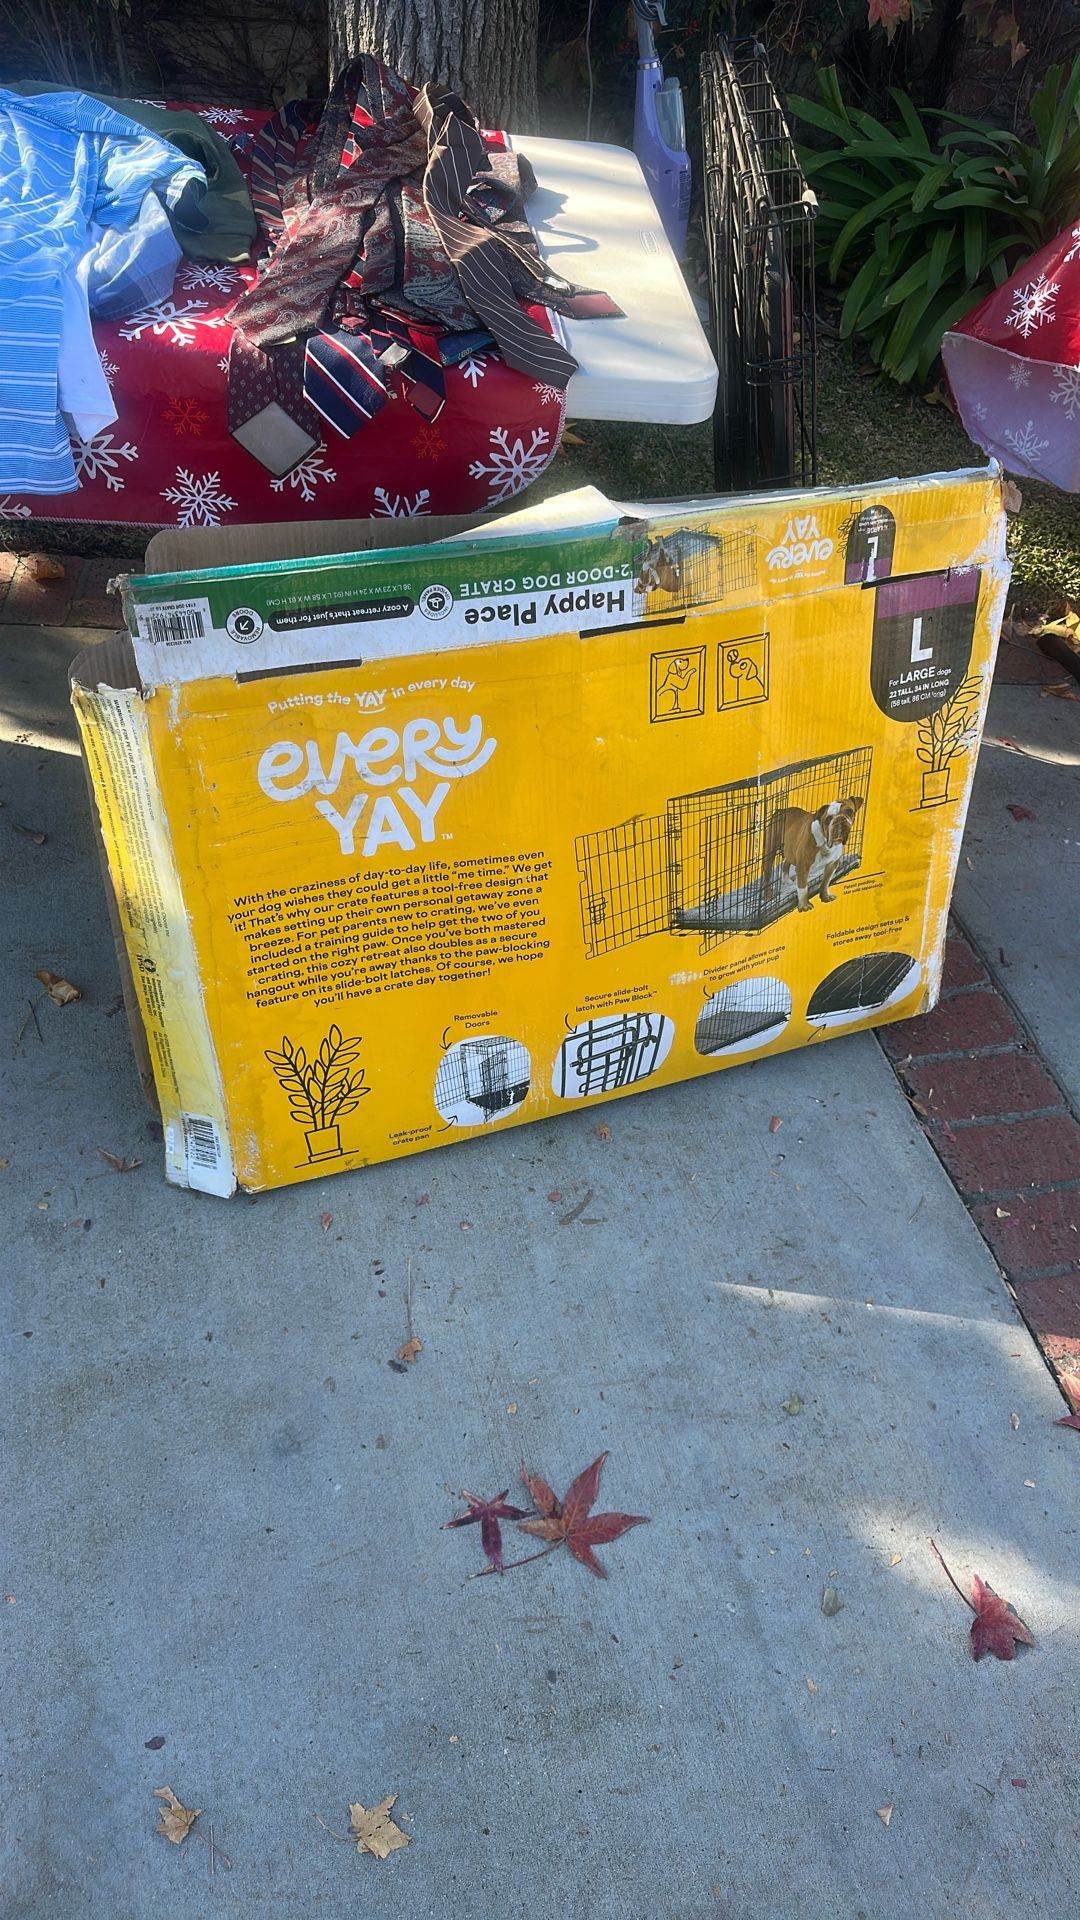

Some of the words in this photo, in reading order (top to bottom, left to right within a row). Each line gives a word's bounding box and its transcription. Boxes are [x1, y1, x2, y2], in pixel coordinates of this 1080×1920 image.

[782, 515, 820, 545] YAY
[523, 574, 560, 589] DOG
[567, 564, 629, 584] 2-DOOR
[460, 579, 516, 596] CRATE
[353, 608, 381, 616] retreat
[544, 590, 625, 616] Happy
[232, 610, 254, 618] DOORS
[276, 616, 297, 625] them
[313, 612, 328, 620] just
[465, 602, 536, 626] Place
[231, 626, 260, 641] REMOVABLE
[911, 617, 933, 662] L
[889, 679, 899, 687] For
[900, 666, 936, 684] LARGE
[937, 668, 951, 676] dogs
[268, 694, 323, 714] Putting
[327, 692, 351, 705] the
[354, 689, 387, 707] YAY
[392, 687, 406, 699] in
[408, 678, 448, 693] every
[451, 677, 475, 693] day
[889, 691, 897, 699] 22
[931, 679, 949, 688] LONG
[315, 783, 450, 857] YAY
[233, 893, 264, 907] With
[266, 889, 286, 899] the
[288, 878, 346, 894] craziness
[348, 872, 363, 886] of
[363, 864, 426, 884] day-to-day
[429, 860, 450, 871] life,
[453, 855, 515, 868] sometimes
[517, 851, 544, 861] even
[227, 906, 257, 923] your
[258, 902, 282, 915] dog
[283, 894, 324, 908] wishes
[327, 888, 353, 899] they
[355, 879, 390, 894] could
[389, 877, 411, 892] get
[422, 872, 449, 883] little
[512, 863, 531, 873] We
[533, 860, 552, 872] get
[234, 919, 246, 932] it!
[286, 906, 314, 919] why
[313, 904, 336, 915] our
[336, 897, 368, 911] crate
[370, 889, 420, 903] features
[431, 881, 482, 894] tool-free
[485, 877, 523, 888] design
[524, 872, 548, 883] that
[244, 927, 281, 942] makes
[284, 918, 325, 932] setting
[327, 914, 344, 924] up
[344, 907, 374, 922] their
[376, 902, 400, 913] own
[403, 894, 453, 911] personal
[455, 891, 504, 904] getaway
[506, 885, 533, 897] zone
[249, 937, 294, 952] breeze.
[296, 930, 317, 941] For
[319, 923, 342, 938] pet
[342, 917, 387, 934] parents
[389, 913, 413, 923] new
[430, 903, 475, 917] crating,
[512, 897, 538, 907] even
[827, 929, 855, 940] Foldable
[856, 924, 879, 933] design
[247, 957, 290, 976] started
[292, 956, 307, 965] on
[309, 951, 329, 963] the
[331, 944, 360, 958] right
[362, 940, 389, 953] paw.
[391, 934, 422, 945] Once
[464, 924, 491, 935] both
[493, 917, 545, 932] mastered
[250, 943, 302, 964] included
[313, 934, 360, 949] training
[361, 926, 394, 941] guide
[396, 925, 412, 936] to
[411, 919, 439, 935] help
[438, 917, 460, 931] get
[459, 915, 479, 924] the
[481, 914, 503, 922] two
[505, 909, 518, 919] of
[519, 909, 540, 919] you
[833, 938, 854, 947] stores
[874, 927, 902, 937] tool-free
[704, 964, 728, 976] Divider
[730, 957, 747, 969] panel
[748, 951, 767, 962] allows
[768, 945, 785, 954] crate
[718, 971, 735, 980] grow
[736, 964, 750, 973] with
[751, 960, 765, 969] your
[767, 955, 779, 964] pup
[345, 988, 372, 999] have
[383, 980, 413, 991] crate
[416, 976, 436, 985] day
[438, 967, 490, 982] together!
[585, 994, 612, 1002] Secure
[614, 985, 648, 996] slide-bolt
[454, 1011, 498, 1021] Removable
[576, 1004, 595, 1012] latch
[597, 1000, 613, 1009] with
[466, 1021, 490, 1029] Doors
[389, 1125, 432, 1139] Leak-proof
[393, 1138, 414, 1146] crate
[415, 1134, 430, 1142] pan
